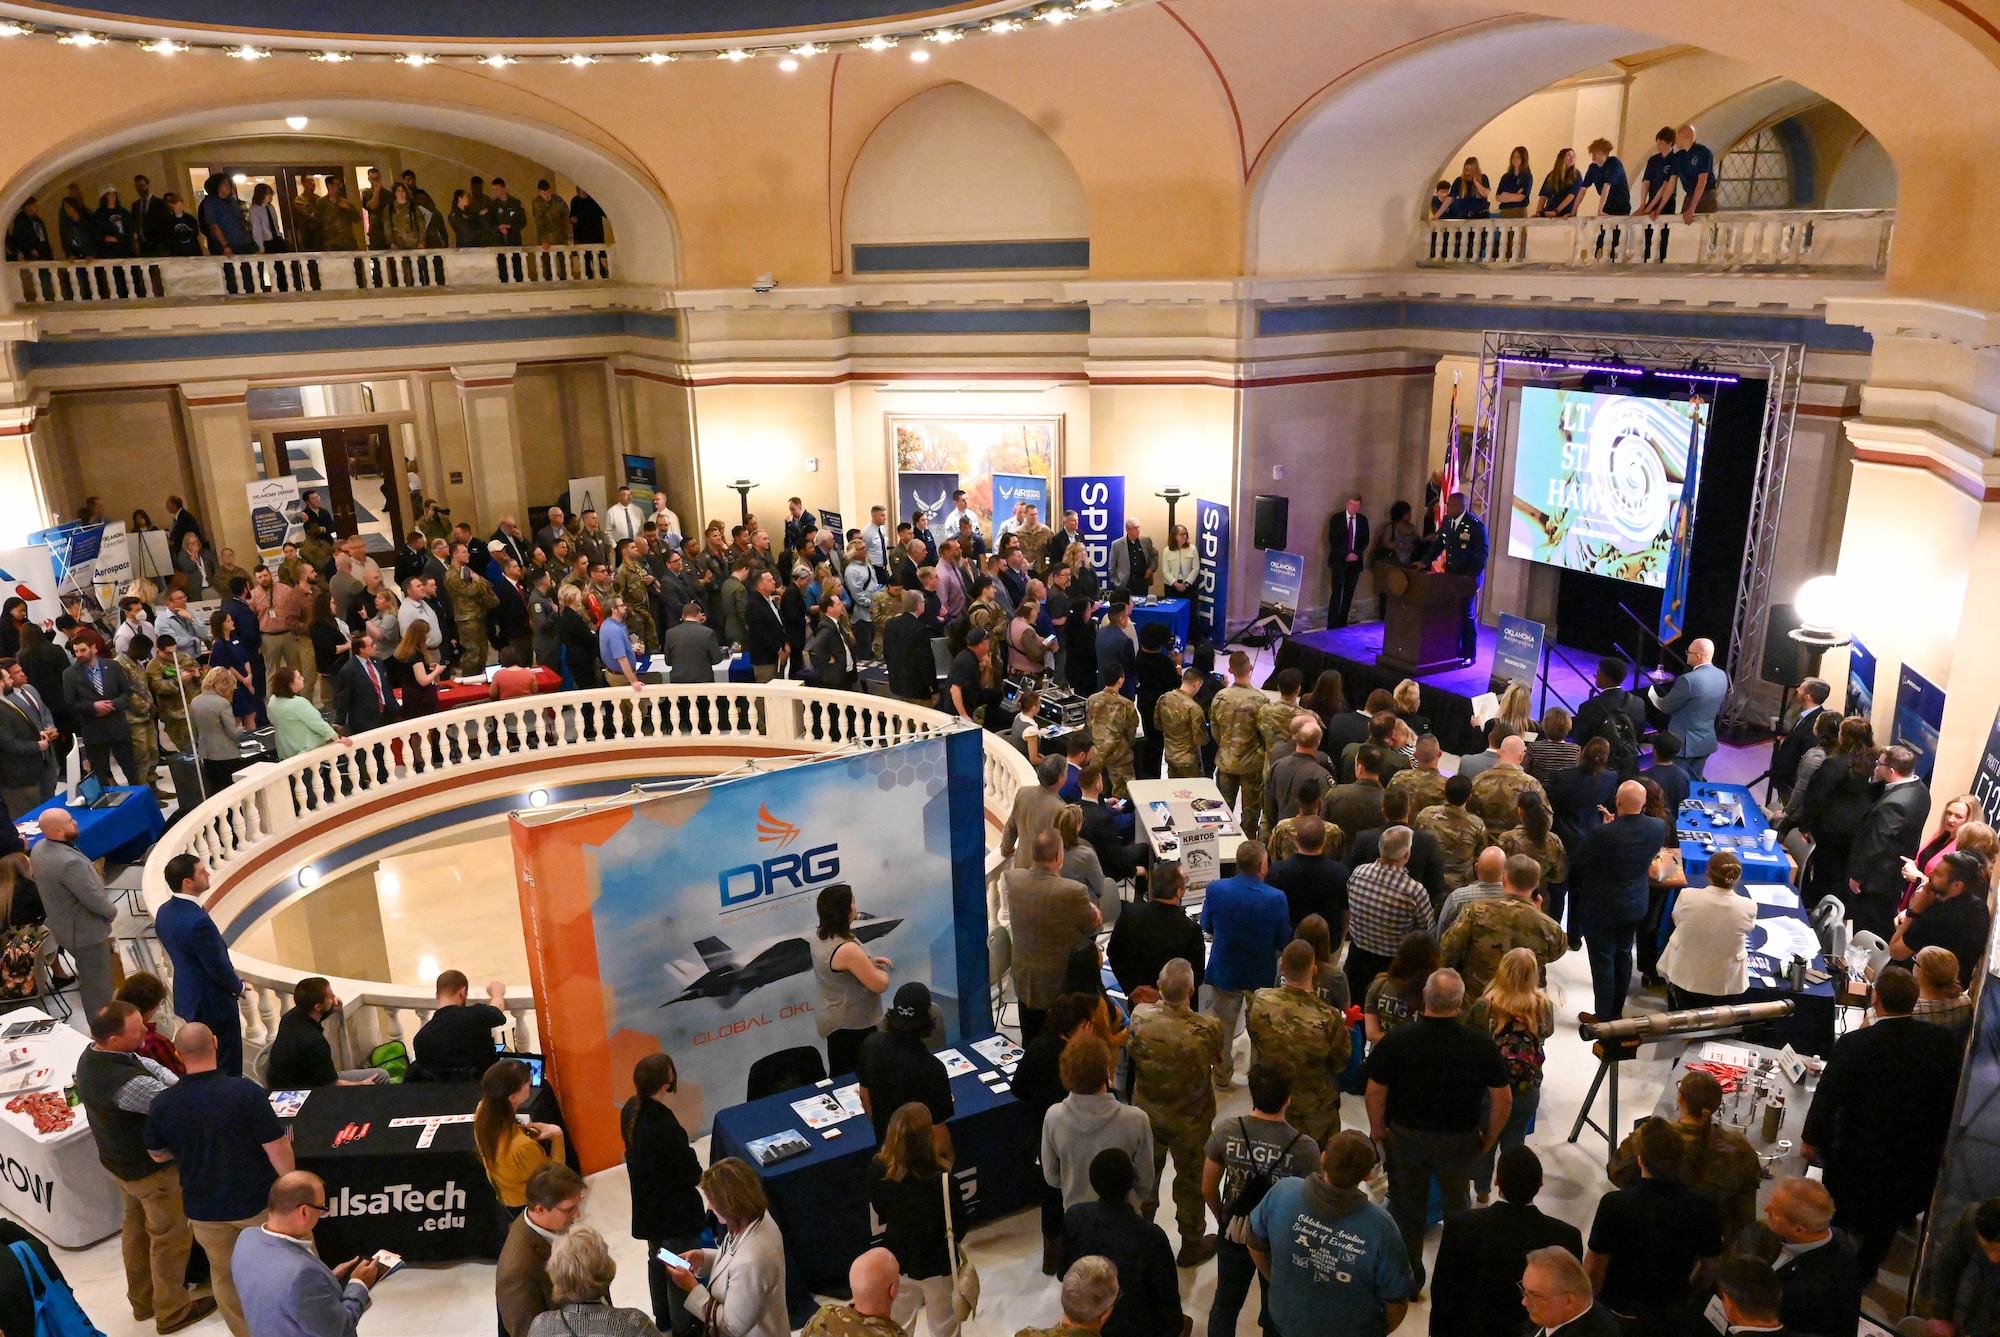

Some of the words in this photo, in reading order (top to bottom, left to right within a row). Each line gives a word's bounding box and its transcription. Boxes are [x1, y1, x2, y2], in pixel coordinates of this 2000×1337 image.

[252, 492, 277, 500] OKLAHOMA
[277, 489, 295, 497] DEFENSE
[103, 532, 125, 542] OKLAHOMA
[94, 561, 130, 578] Aerospace
[1197, 507, 1220, 627] SPIRIT
[1270, 561, 1296, 572] OKLAHOMA
[1503, 628, 1535, 643] OKLAHOMA
[1503, 635, 1534, 649] Aeronautics
[718, 843, 840, 907] DRG
[530, 905, 539, 937] Serve
[693, 1014, 773, 1045] GLOBAL
[320, 1181, 467, 1218] ulsaTech
[418, 1212, 466, 1232] .edu
[1297, 1213, 1333, 1234] Oklahoma
[1336, 1229, 1366, 1246] Aviation
[1292, 1222, 1318, 1238] Schools
[1319, 1234, 1329, 1244] of
[1328, 1236, 1367, 1255] Excellence
